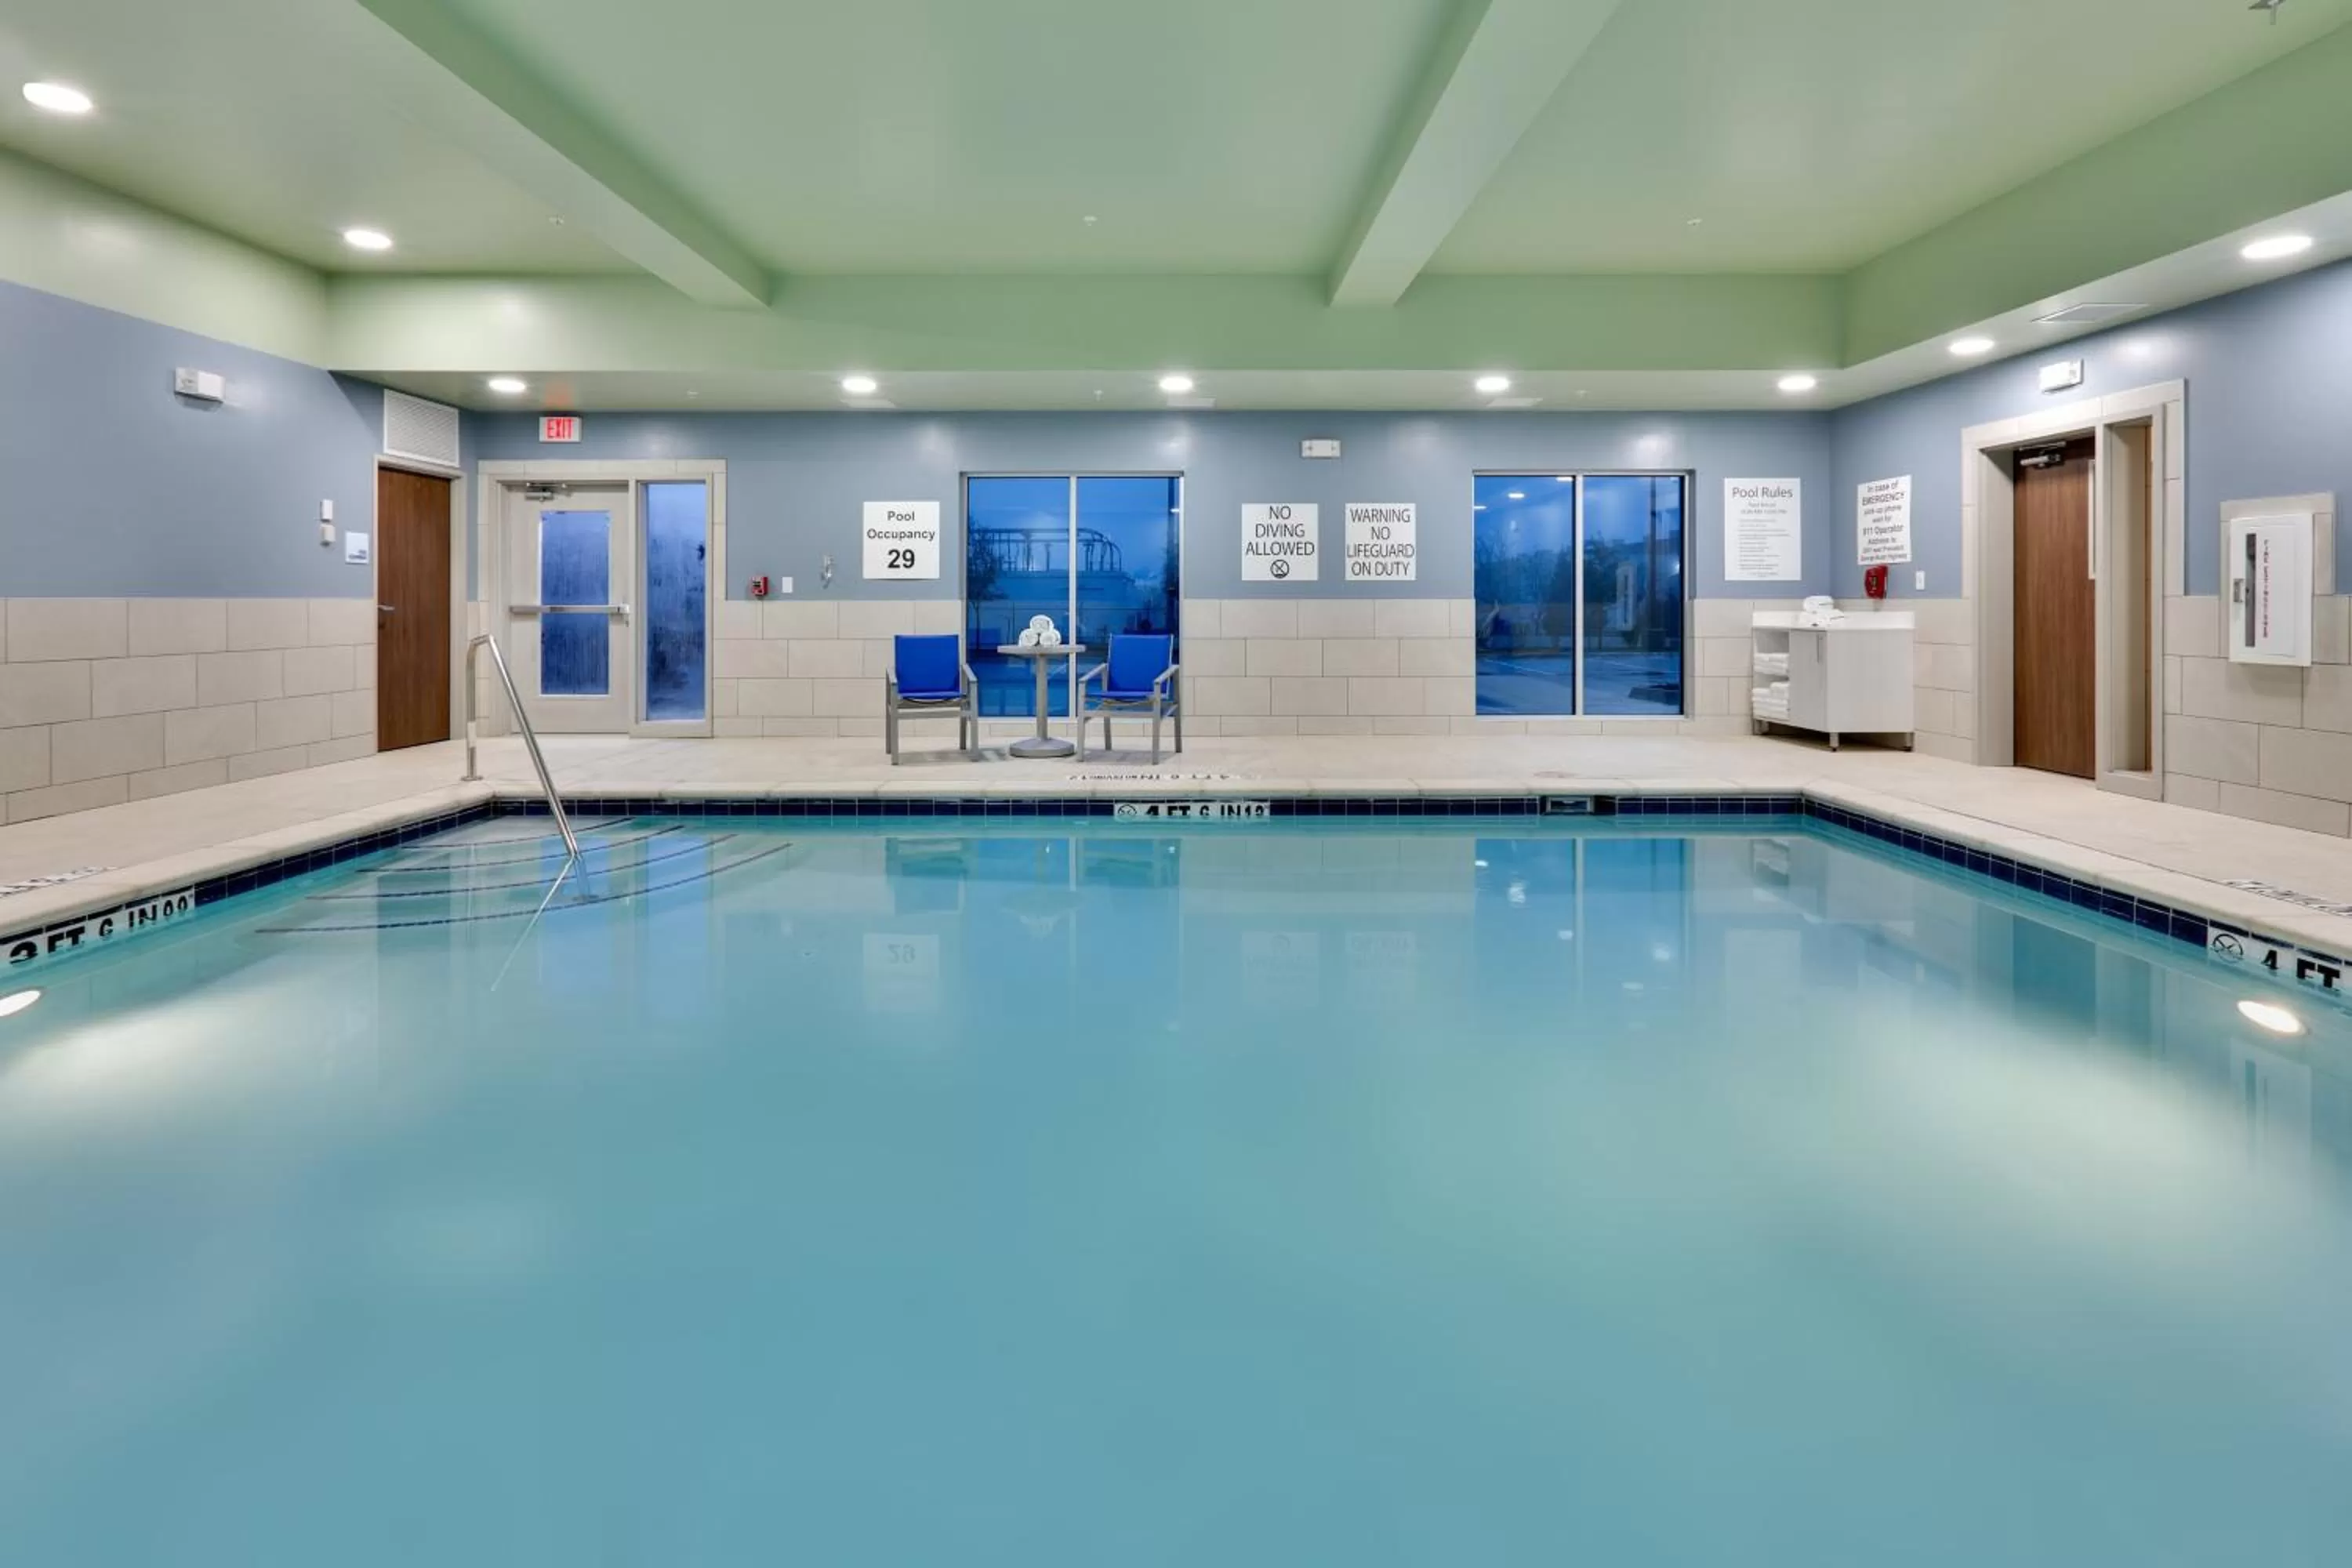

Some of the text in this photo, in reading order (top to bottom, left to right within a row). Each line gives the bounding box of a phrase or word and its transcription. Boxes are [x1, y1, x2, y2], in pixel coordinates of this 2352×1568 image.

[546, 418, 572, 439] EXIT
[1732, 485, 1793, 498] Pool Rules
[887, 511, 915, 521] Pool
[1269, 506, 1291, 519] NO
[1350, 508, 1410, 523] WARNING
[866, 528, 935, 542] Occupancy
[1255, 523, 1305, 538] DIVING
[1371, 526, 1391, 539] NO
[1245, 541, 1315, 555] ALLOWED
[1347, 543, 1415, 557] LIFEGUARD
[887, 548, 915, 568] 29
[1351, 561, 1410, 576] ON DUTY
[2296, 958, 2340, 989] FT
